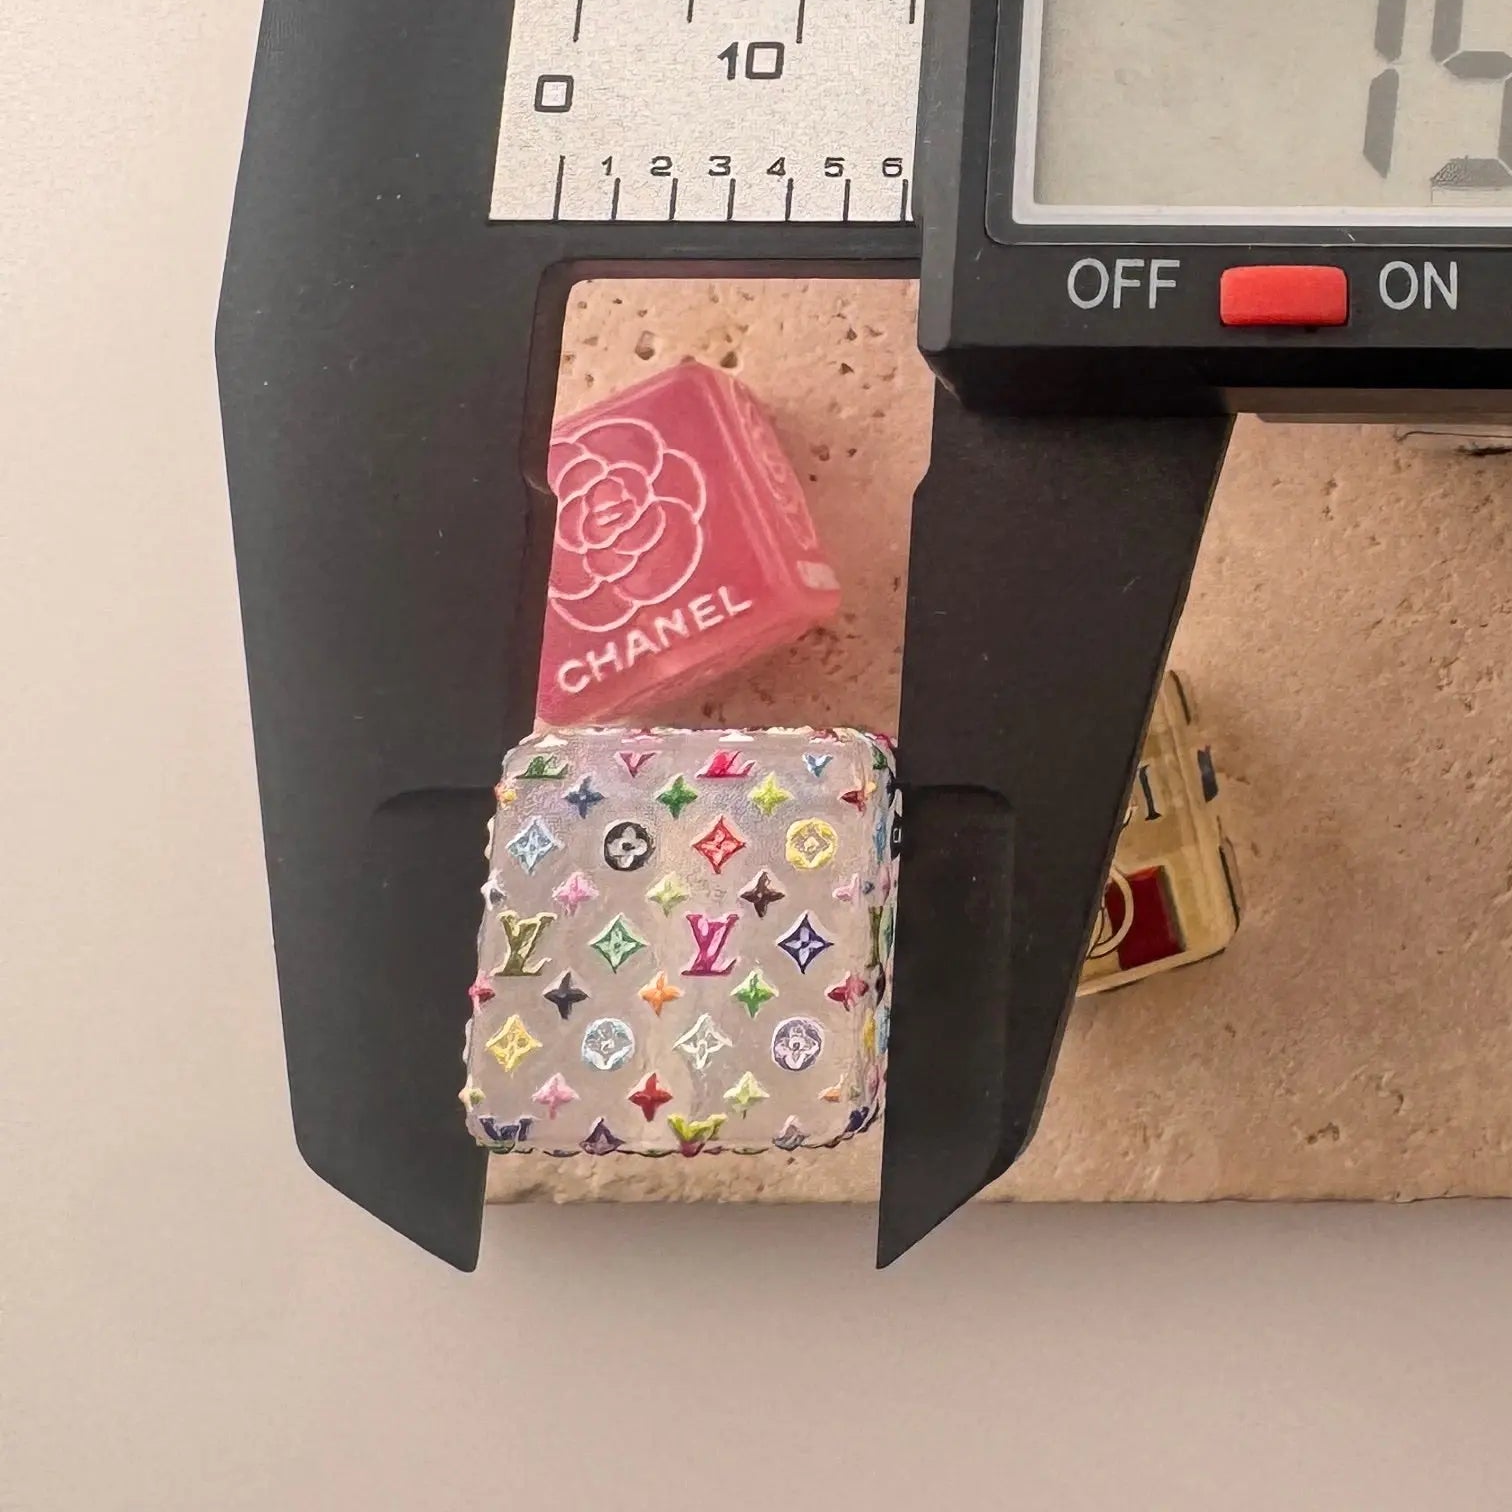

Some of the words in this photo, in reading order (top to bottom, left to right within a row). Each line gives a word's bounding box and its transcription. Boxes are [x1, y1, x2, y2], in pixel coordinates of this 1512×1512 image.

[717, 40, 786, 81] 10
[534, 74, 575, 113] 0
[600, 155, 614, 177] 1
[650, 155, 673, 177] 2
[708, 155, 732, 177] 3
[765, 156, 787, 177] 4
[823, 156, 845, 178] 5
[881, 156, 904, 178] 6
[1066, 258, 1182, 310] OFF
[1377, 260, 1460, 310] ON
[556, 585, 754, 694] CHANEL
